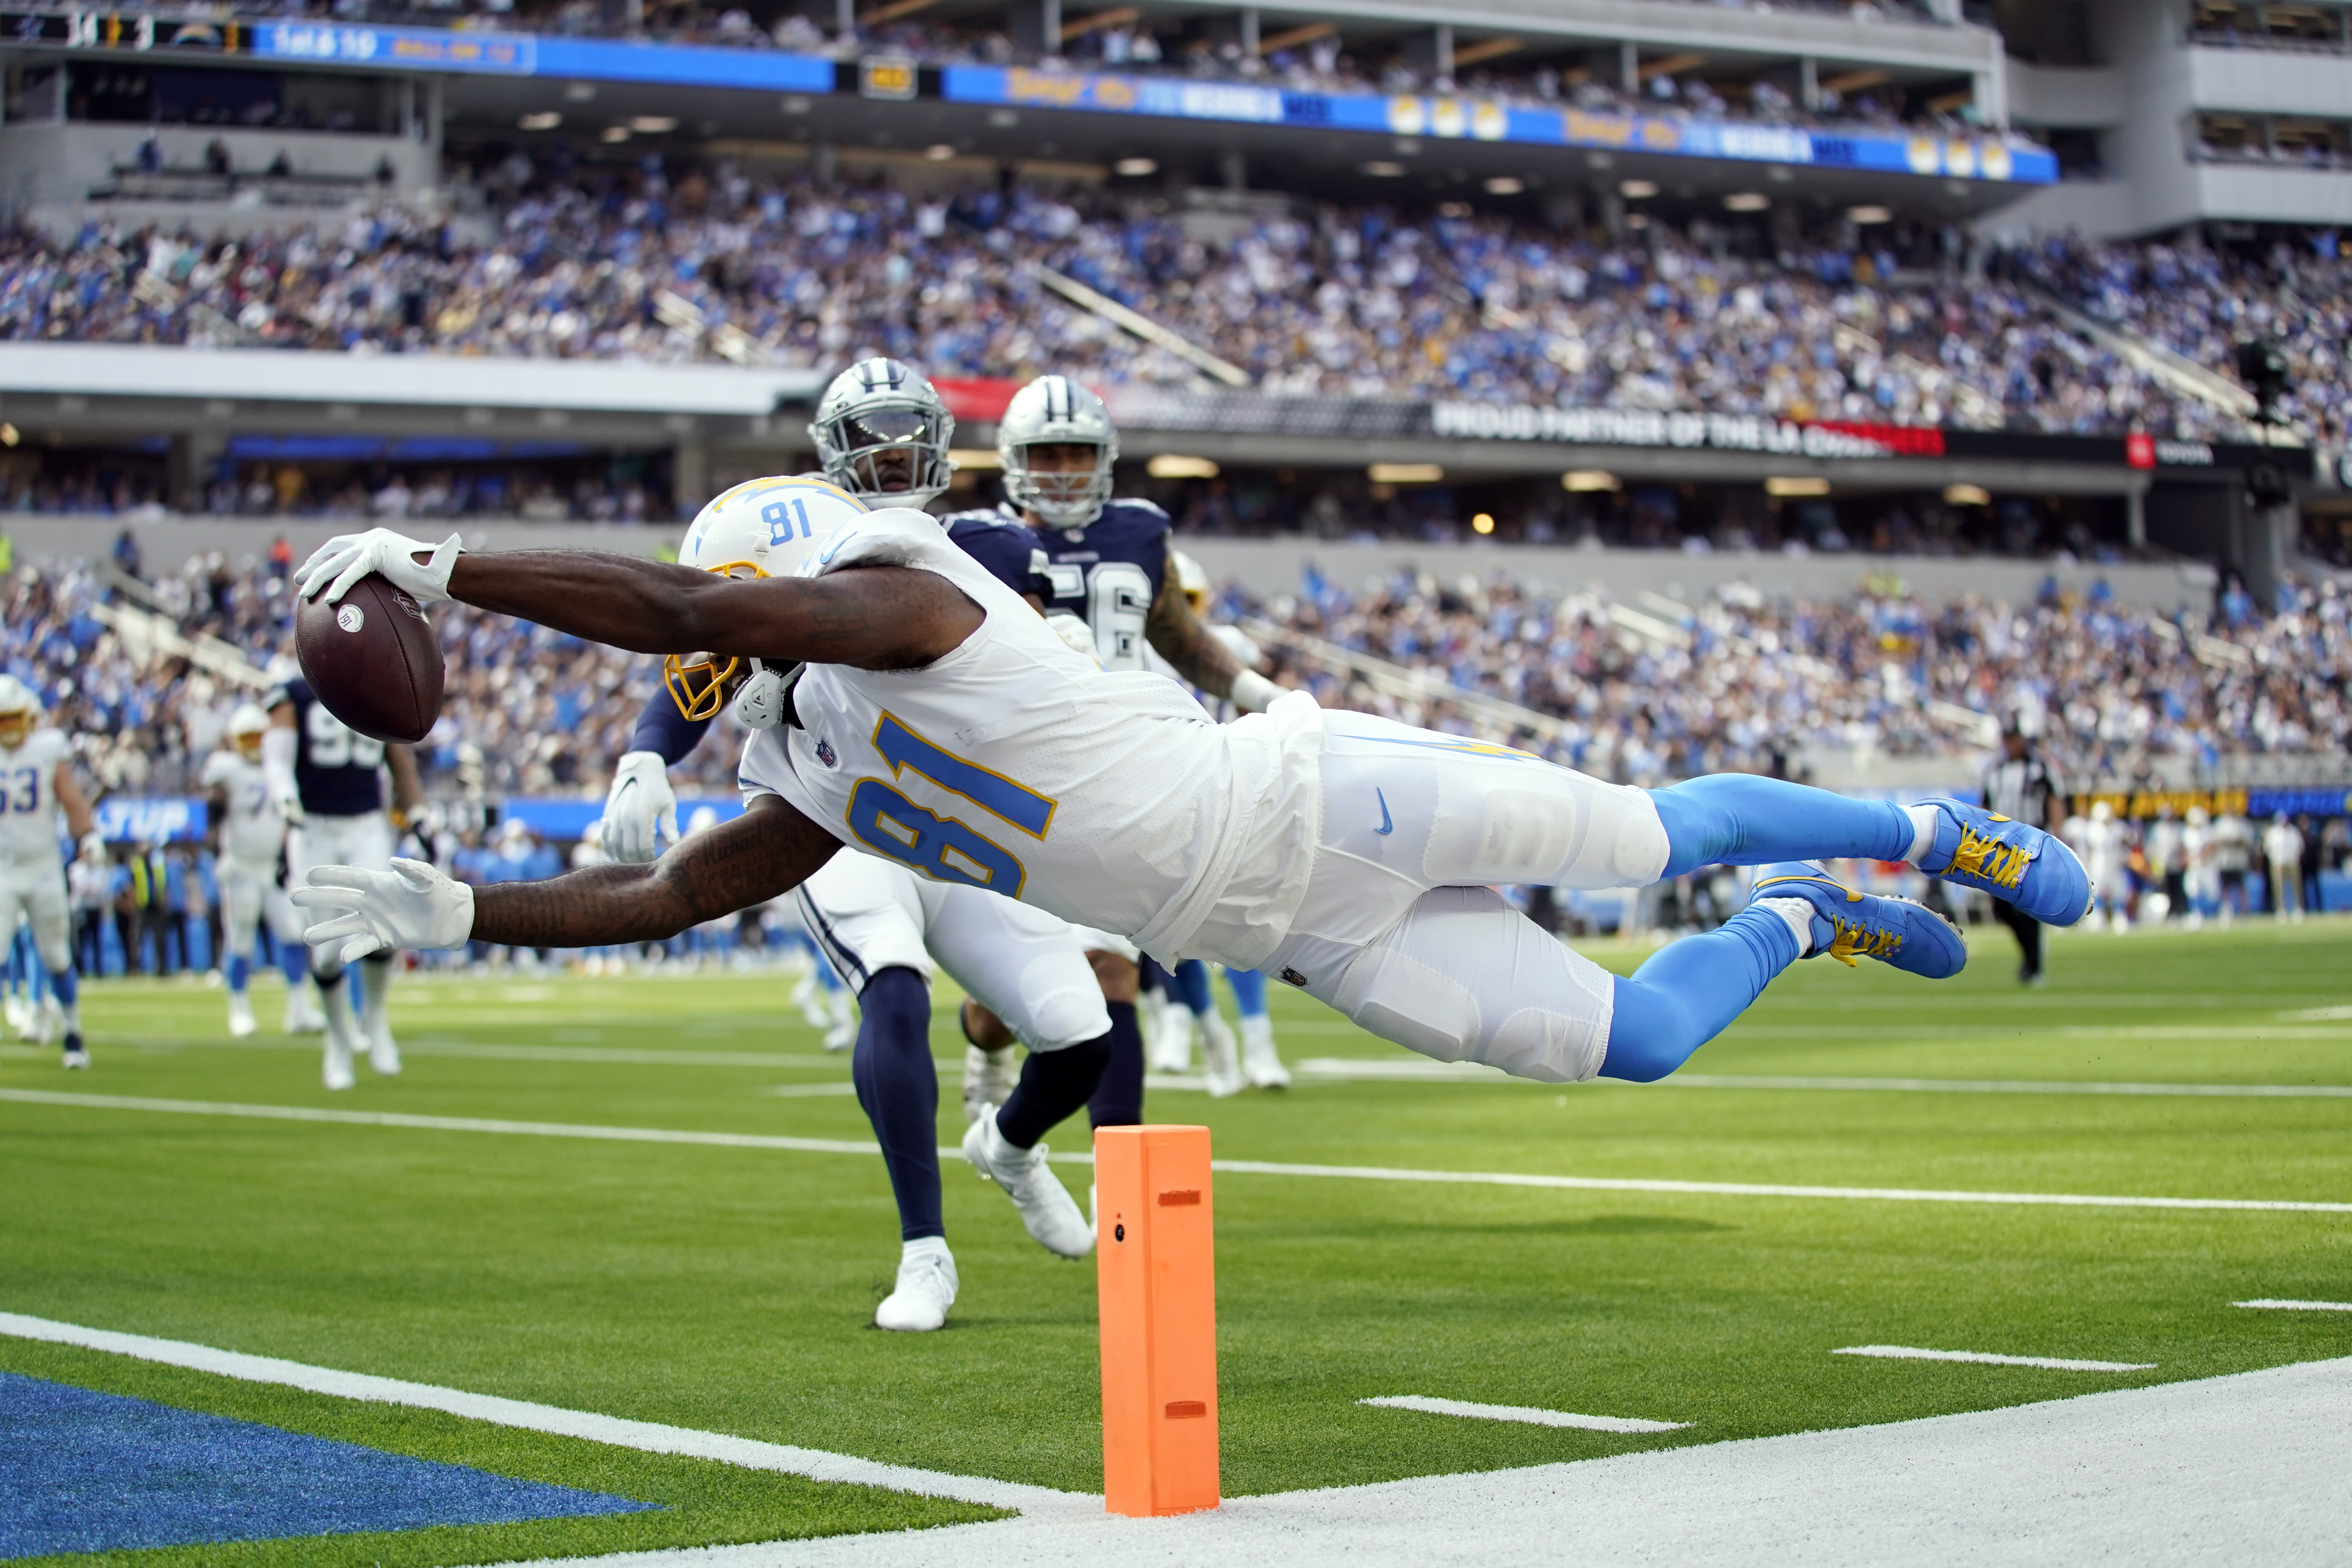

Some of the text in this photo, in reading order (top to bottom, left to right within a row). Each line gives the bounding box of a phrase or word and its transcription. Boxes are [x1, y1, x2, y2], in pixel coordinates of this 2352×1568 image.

[1433, 401, 1537, 440] PROUD
[1540, 406, 1666, 446] PARTNER
[1668, 410, 1707, 448] OF
[1710, 412, 1760, 450] THE
[761, 498, 811, 546] 81
[339, 612, 352, 627] 191
[822, 749, 834, 765] NFL
[0, 766, 39, 814] 3
[845, 708, 1059, 901] 81
[686, 821, 762, 871] Michael
